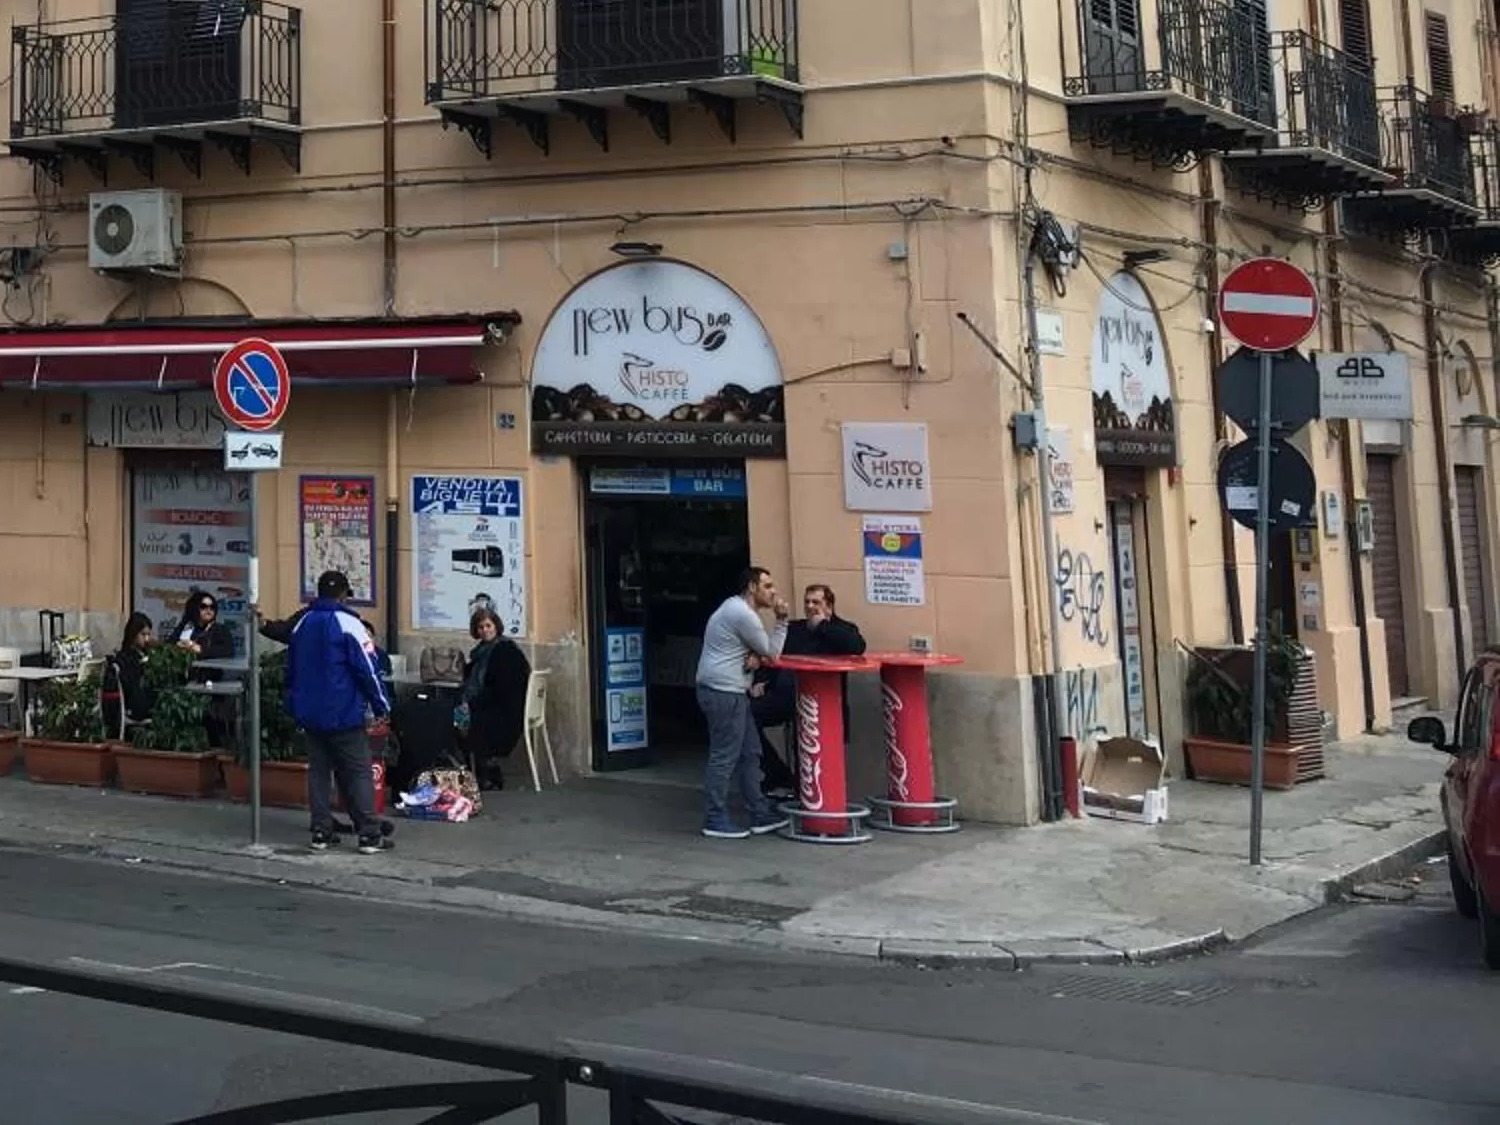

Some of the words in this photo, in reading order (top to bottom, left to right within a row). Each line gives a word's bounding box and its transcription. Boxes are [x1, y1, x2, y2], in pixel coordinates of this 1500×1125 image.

[707, 312, 732, 326] BAR
[639, 370, 689, 387] HISTO
[544, 430, 612, 445] CAFFETTERIA
[627, 431, 696, 445] PASTICCERIA
[712, 432, 773, 445] GELATERIA
[872, 460, 923, 476] HISTO
[425, 477, 507, 492] VENDITA
[693, 479, 724, 492] BAR
[419, 489, 513, 504] BIGLIETTI
[418, 501, 518, 516] AST
